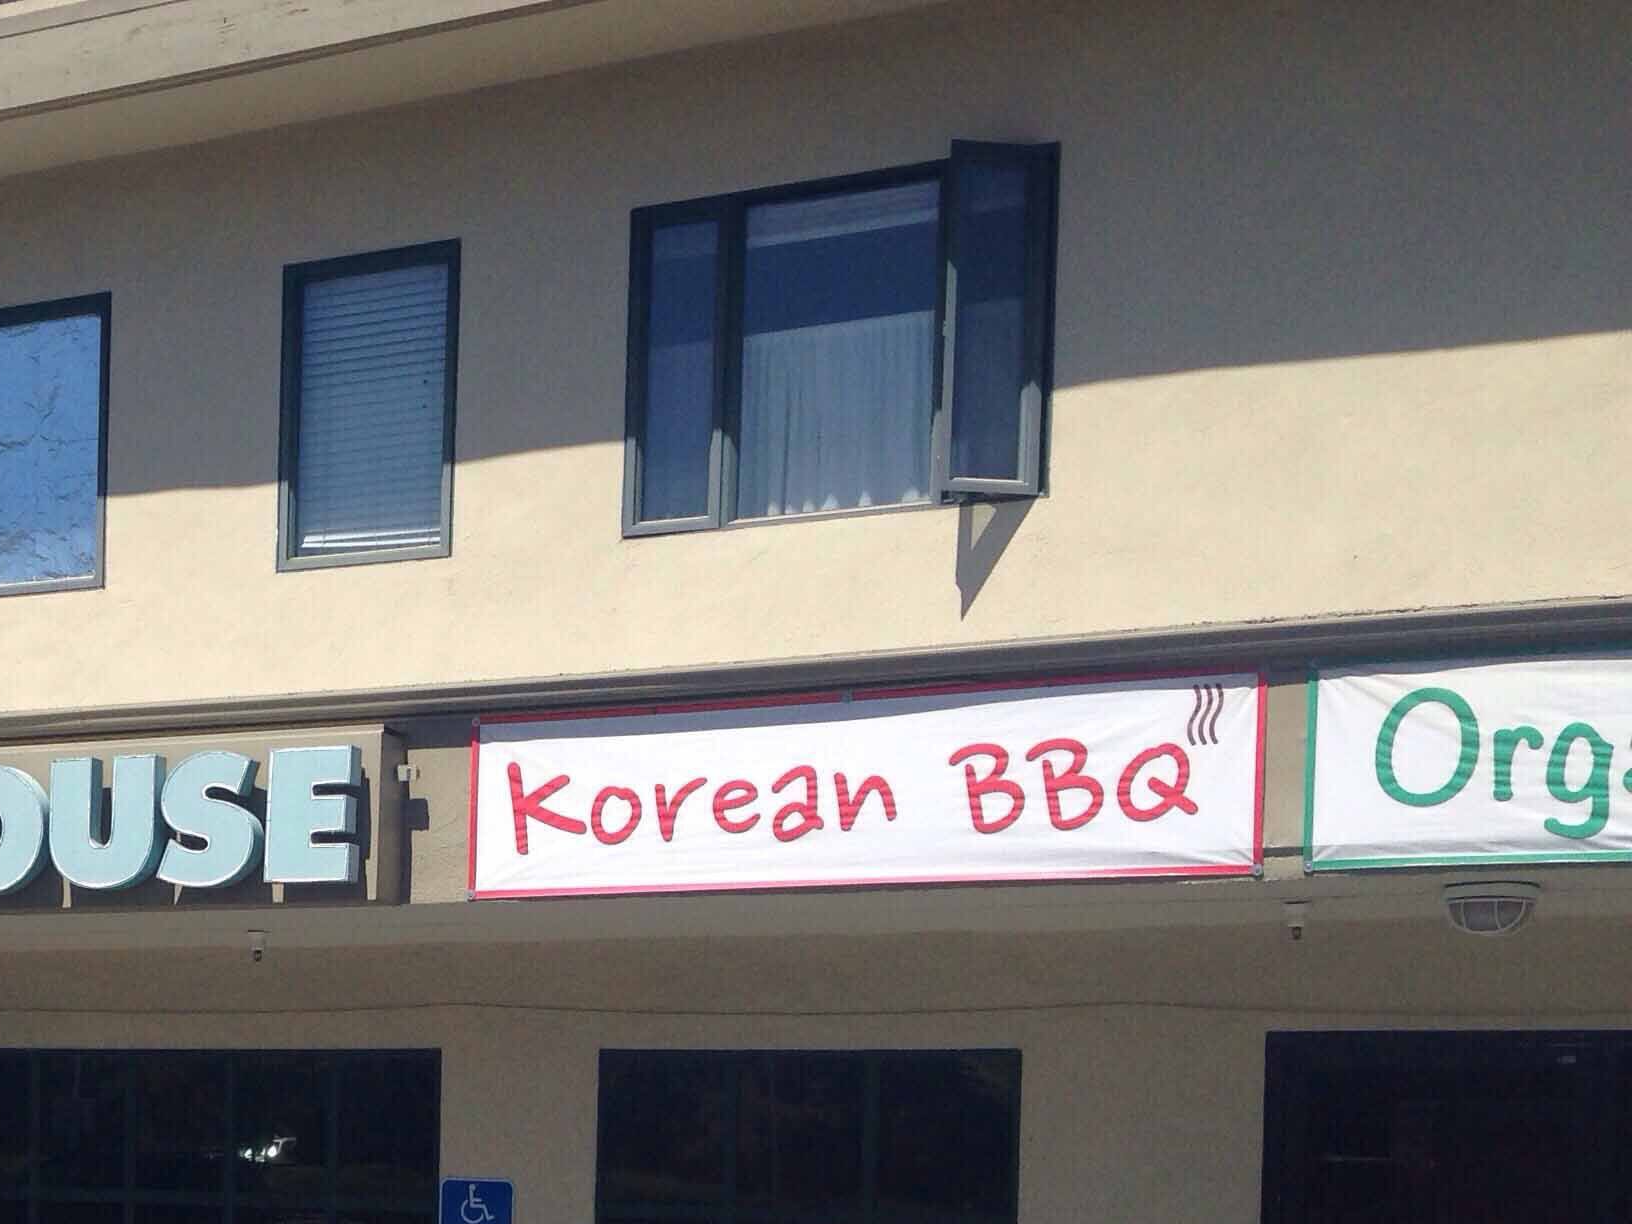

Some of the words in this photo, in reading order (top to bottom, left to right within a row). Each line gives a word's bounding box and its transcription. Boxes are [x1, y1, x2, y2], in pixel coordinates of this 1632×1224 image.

[507, 762, 898, 855] Korean
[949, 738, 1198, 835] BBQ
[1375, 687, 1632, 839] Org
